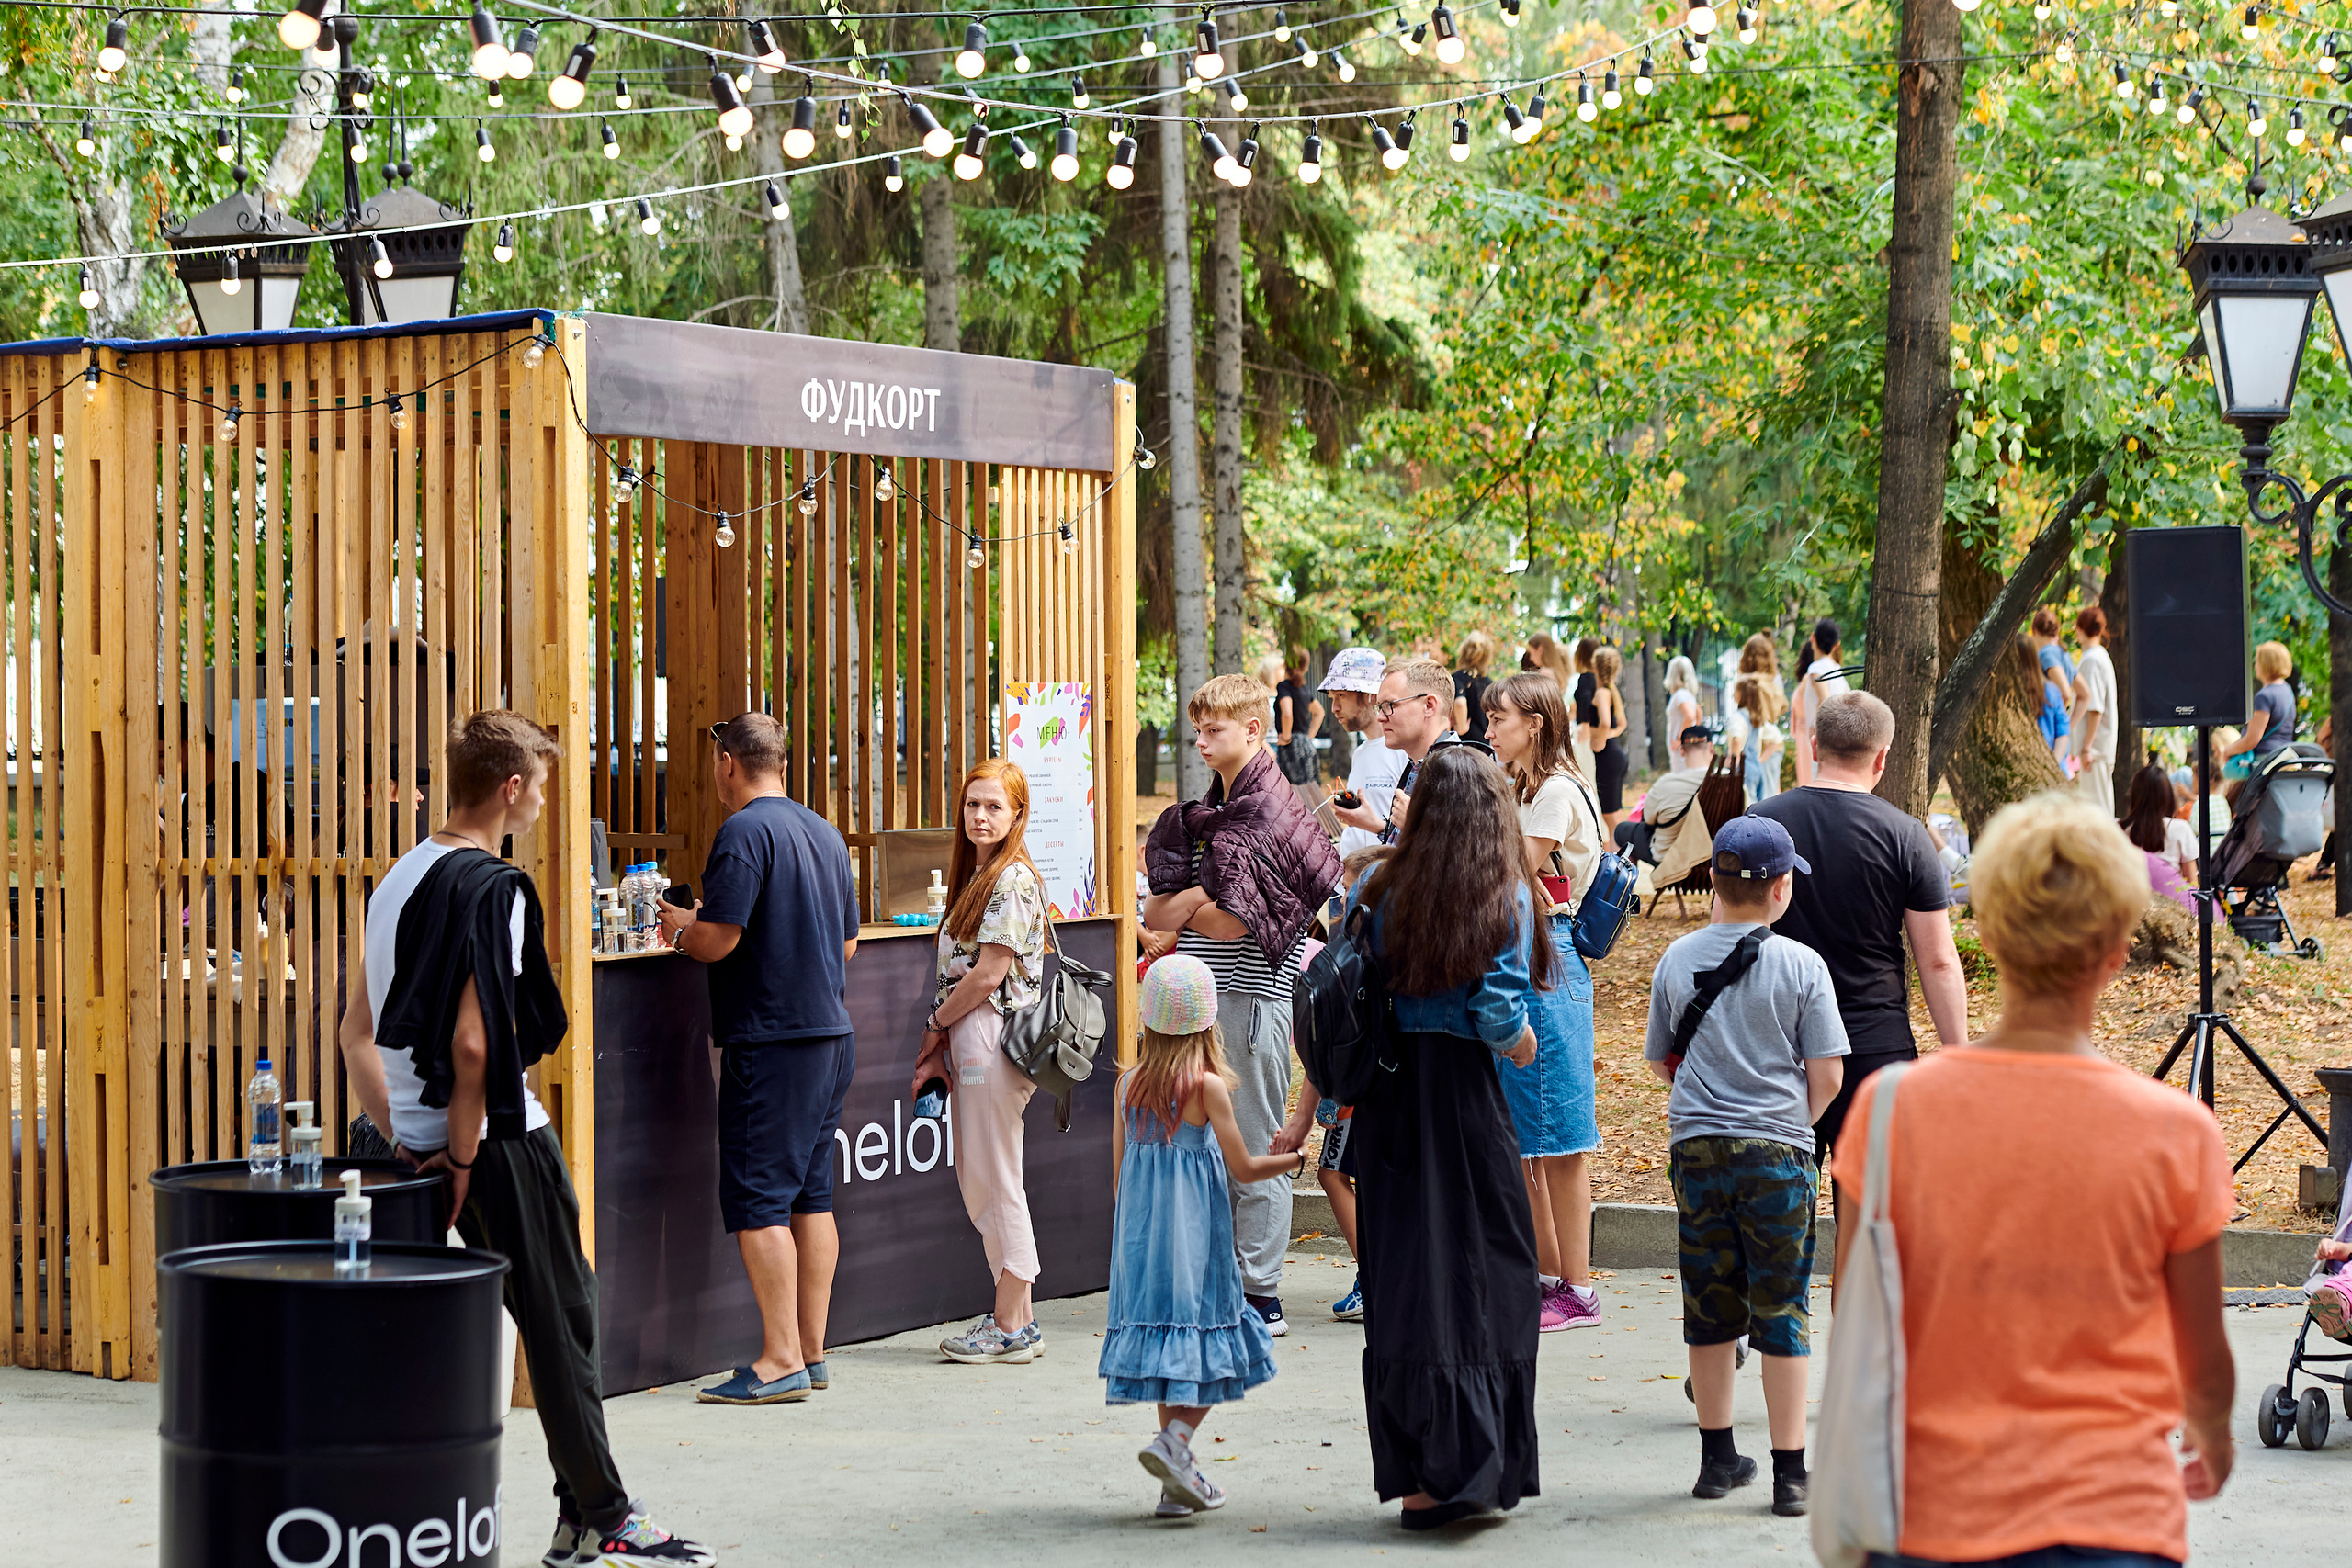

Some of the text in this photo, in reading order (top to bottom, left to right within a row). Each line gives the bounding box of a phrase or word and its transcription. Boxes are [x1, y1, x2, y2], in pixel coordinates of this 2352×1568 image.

[801, 378, 942, 437] ФУДКОРТ
[1036, 725, 1068, 740] МЕНЮ
[1045, 840, 1064, 849] ДЕСЕРТЫ
[962, 1076, 985, 1085] PUMA
[834, 1091, 954, 1184] nelof
[1323, 1124, 1344, 1169] YORK
[266, 1482, 502, 1568] Onelof
